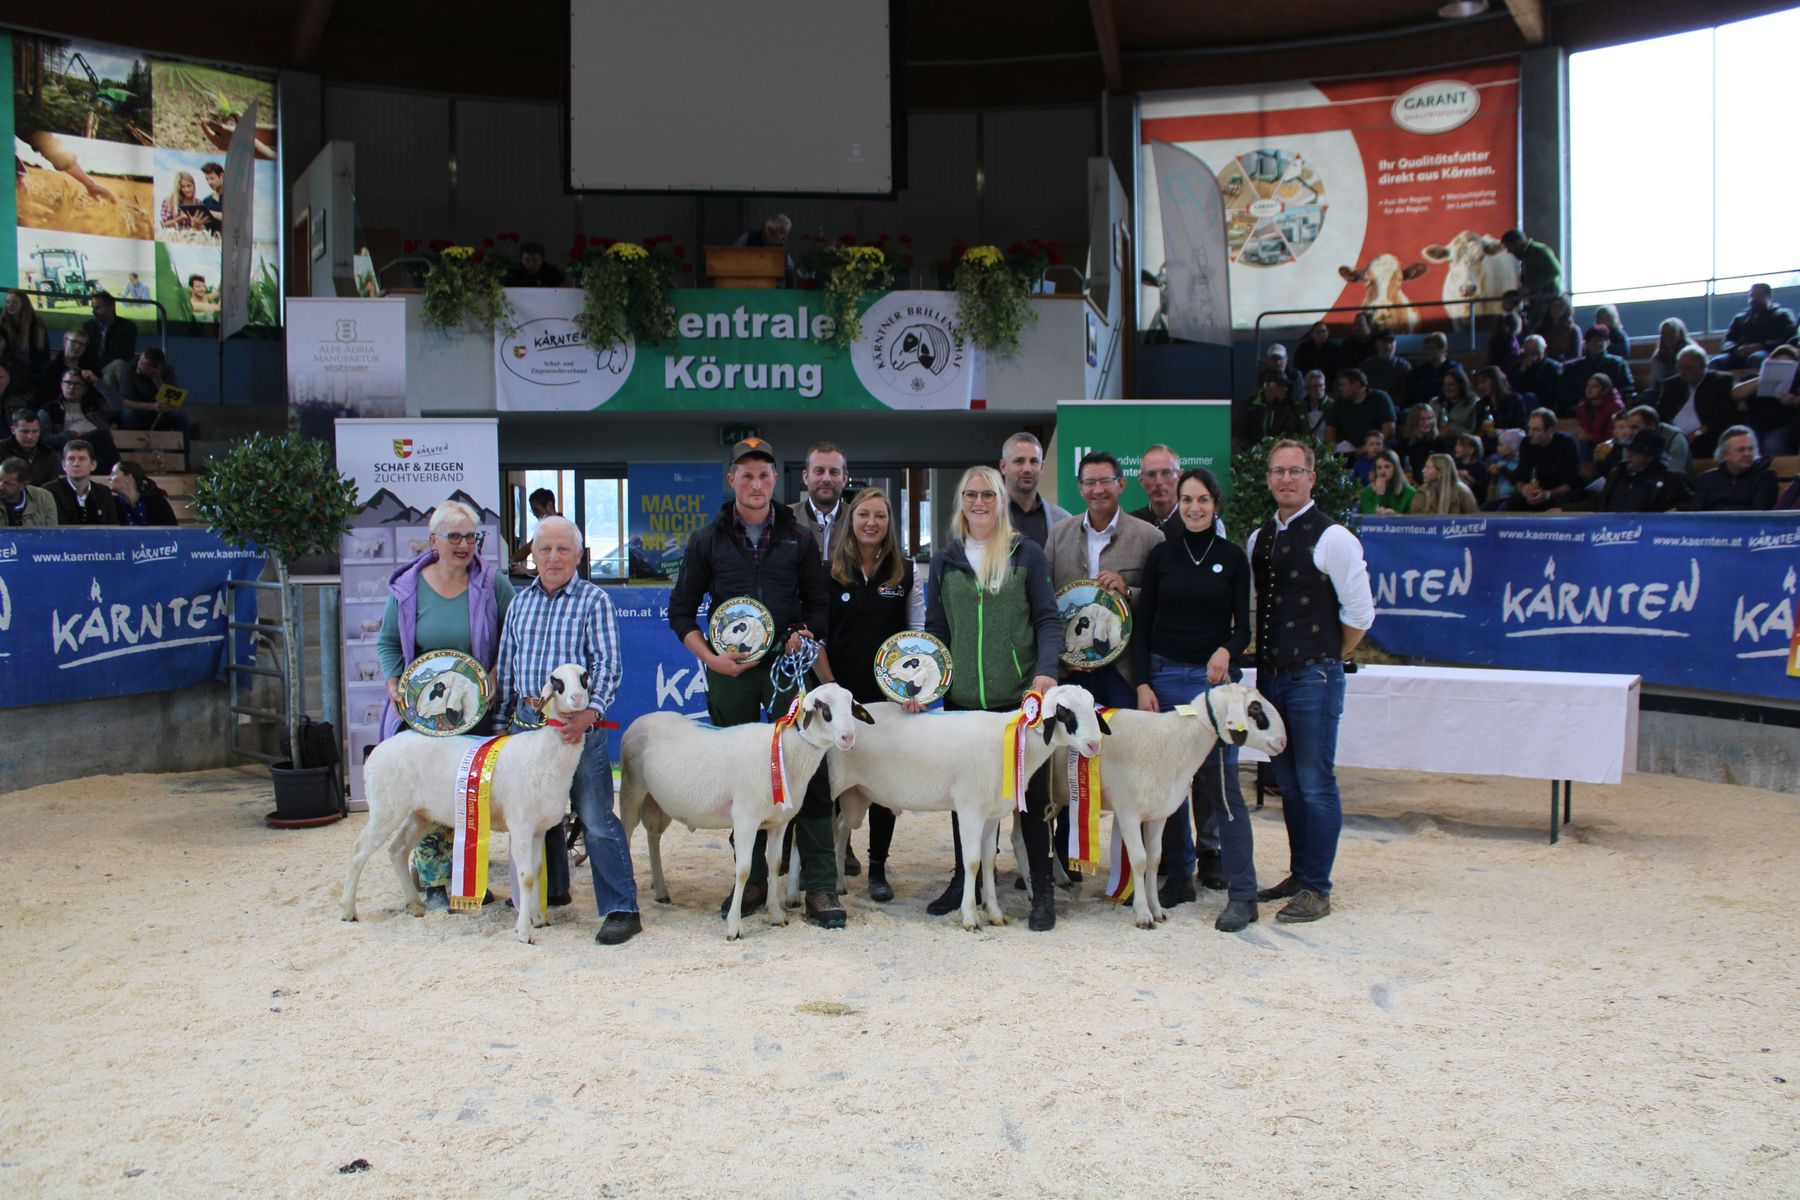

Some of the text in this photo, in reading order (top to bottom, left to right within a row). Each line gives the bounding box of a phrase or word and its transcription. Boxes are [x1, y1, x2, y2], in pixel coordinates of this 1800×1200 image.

[1404, 91, 1468, 110] GARANT
[1379, 160, 1395, 171] Ihr
[1379, 172, 1414, 185] direkt
[1417, 171, 1439, 181] aus
[667, 305, 836, 339] entrale
[873, 311, 903, 370] KÄRNTNER
[313, 355, 380, 363] MANUFAKTUR
[665, 355, 823, 398] Körung
[374, 462, 464, 472] SCHAF & ZIEGEN
[374, 473, 464, 483] ZUCHTVERBAND
[649, 513, 709, 532] NICHT
[1361, 525, 1437, 535] www.kaernten.at
[1499, 530, 1585, 542] www.kaernten.at
[1653, 536, 1742, 547] www.kaernten.at
[33, 552, 125, 562] www.kaernten.at
